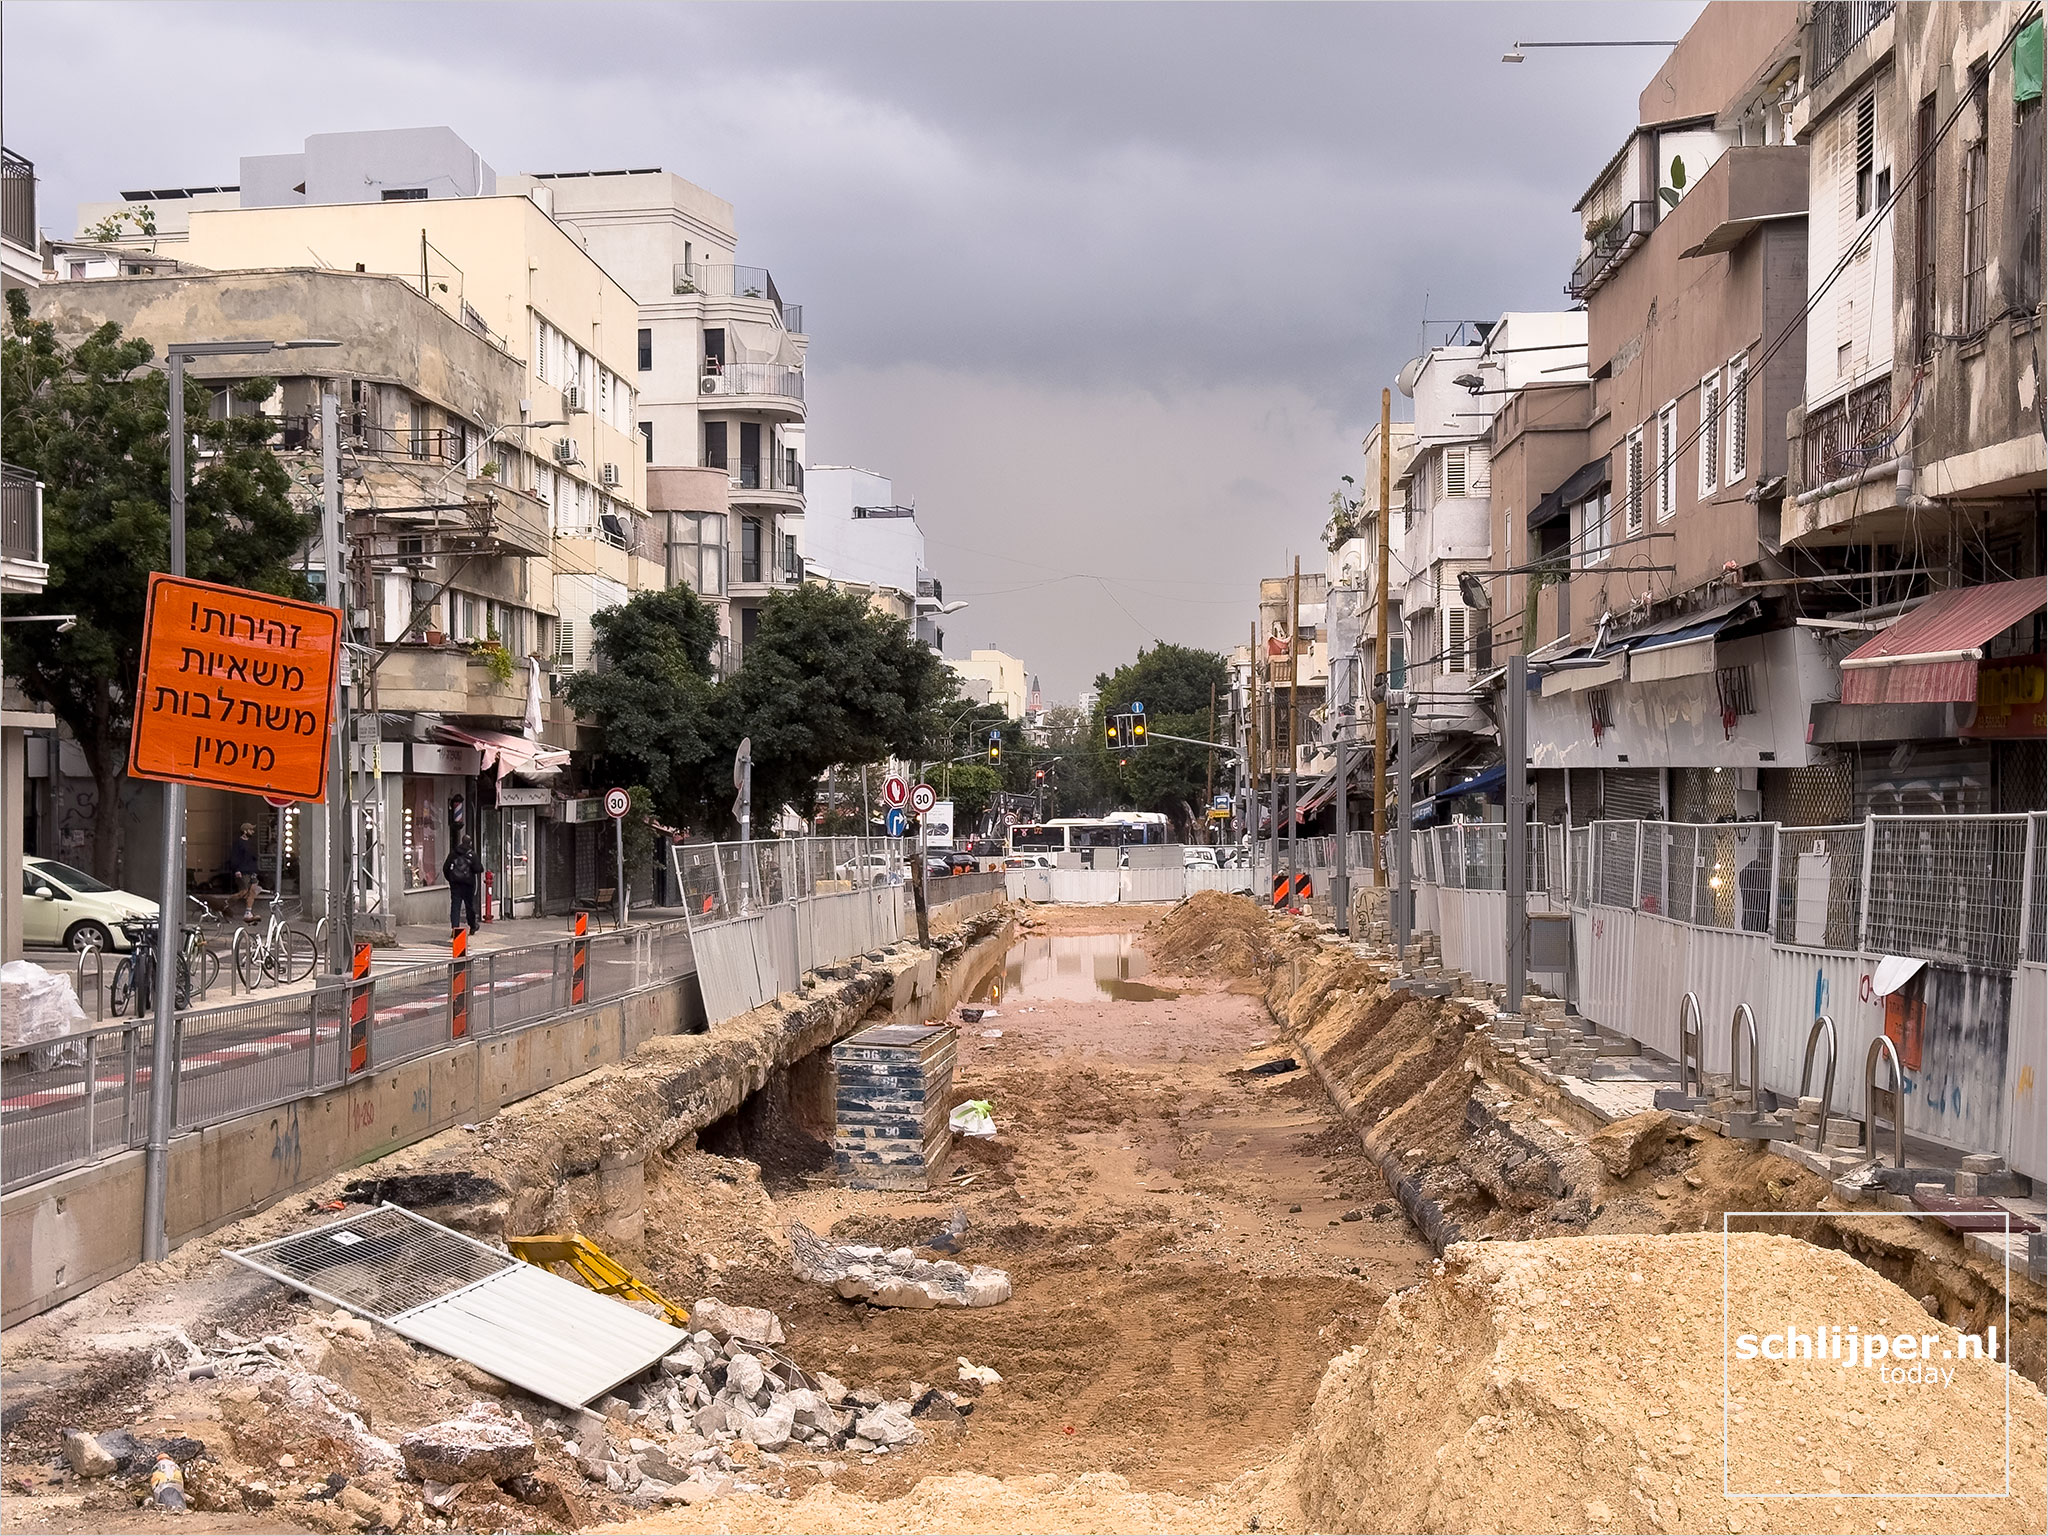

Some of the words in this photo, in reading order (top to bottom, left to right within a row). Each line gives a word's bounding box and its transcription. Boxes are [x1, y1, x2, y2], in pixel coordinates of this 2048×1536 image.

[190, 601, 302, 649] זהירות!
[179, 647, 304, 692] משאיות
[152, 686, 316, 736] משתלבות
[193, 736, 275, 772] מימין
[610, 798, 624, 809] 30
[916, 794, 929, 805] 30
